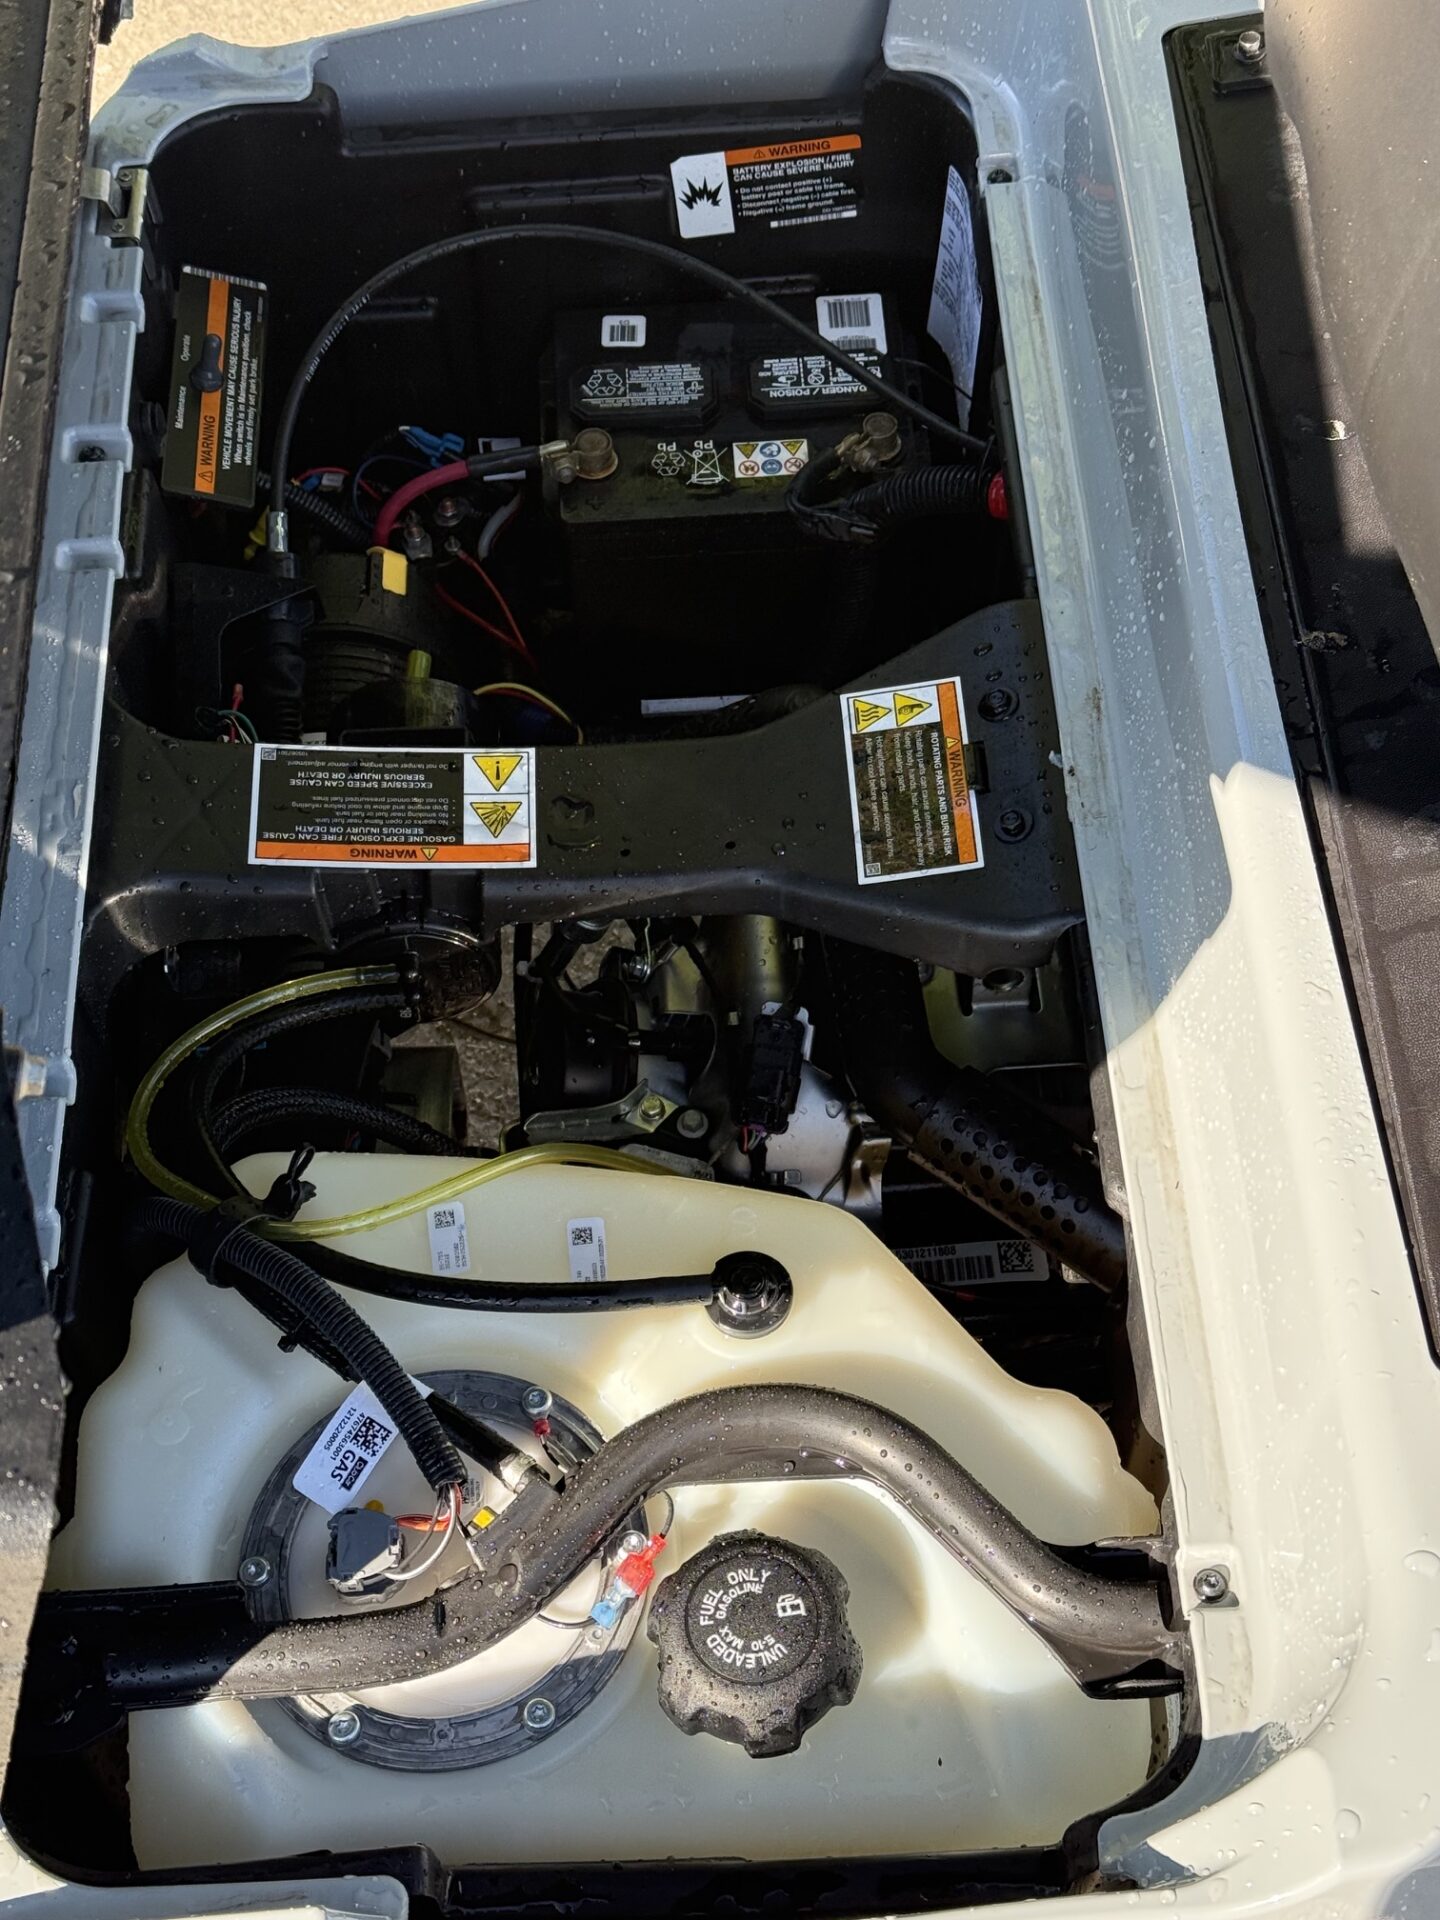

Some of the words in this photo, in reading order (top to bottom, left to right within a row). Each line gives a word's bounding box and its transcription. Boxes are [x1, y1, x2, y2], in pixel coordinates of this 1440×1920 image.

[769, 141, 830, 156] WARNING
[733, 164, 771, 176] BATTERY
[774, 157, 824, 170] EXPLOSION
[831, 153, 851, 162] FIRE
[734, 174, 753, 182] CAN
[754, 169, 784, 179] CAUSE
[787, 164, 821, 175] SEVERE
[823, 160, 854, 169] INJURY
[741, 193, 765, 201] battery
[767, 190, 784, 198] post
[794, 186, 813, 194] cable
[765, 182, 791, 190] contact
[793, 179, 821, 188] positive
[742, 198, 779, 208] Disconnect
[781, 195, 809, 203] negative
[743, 208, 773, 216] Negative
[232, 297, 241, 323] INJURY
[180, 335, 190, 361] Operate
[230, 323, 240, 354] SERIOUS
[228, 355, 238, 379] CAUSE
[227, 380, 235, 396] MAY
[238, 361, 248, 403] Maintenance
[249, 378, 257, 394] park
[822, 384, 867, 394] DANGER
[769, 388, 810, 397] POISON
[175, 386, 186, 429] Maintenance
[224, 397, 234, 438] MOVEMENT
[237, 404, 245, 412] in
[245, 406, 256, 426] firmly
[200, 415, 215, 466] WARNING
[236, 420, 244, 443] switch
[222, 439, 232, 469] VEHICLE
[234, 444, 243, 463] When
[244, 442, 253, 466] wheels
[657, 442, 676, 452] Pb
[694, 440, 713, 449] Pb
[865, 737, 873, 755] Allow
[875, 735, 884, 748] Hot
[893, 733, 901, 749] from
[913, 729, 924, 757] Rotating
[931, 732, 942, 769] ROTATING
[867, 756, 874, 764] to
[894, 749, 903, 774] rotating
[917, 758, 926, 775] parts
[298, 771, 329, 779] DEATH
[348, 772, 381, 780] INJURY
[384, 773, 425, 781] SERIOUS
[868, 764, 876, 778] cool
[949, 750, 966, 807] WARNING
[868, 779, 878, 801] before
[935, 770, 945, 795] PARTS
[881, 791, 889, 812] cause
[938, 796, 947, 813] AND
[884, 813, 892, 837] serious
[912, 809, 921, 822] and
[924, 811, 933, 836] serious
[940, 814, 950, 836] BURN
[295, 825, 327, 833] DEATH
[298, 833, 319, 841] CAN
[914, 823, 923, 847] clothes
[350, 848, 417, 859] WARNING
[943, 837, 952, 856] RISK
[917, 848, 925, 866] away
[324, 1407, 356, 1450] 1212220005
[330, 1413, 365, 1460] 47674563001
[331, 1450, 356, 1482] GAS
[727, 1568, 771, 1585] ONLY
[699, 1589, 724, 1626] FUEL
[715, 1582, 764, 1620] GASOLINE
[719, 1625, 744, 1650] MAX
[707, 1635, 788, 1668] UNLEADED
